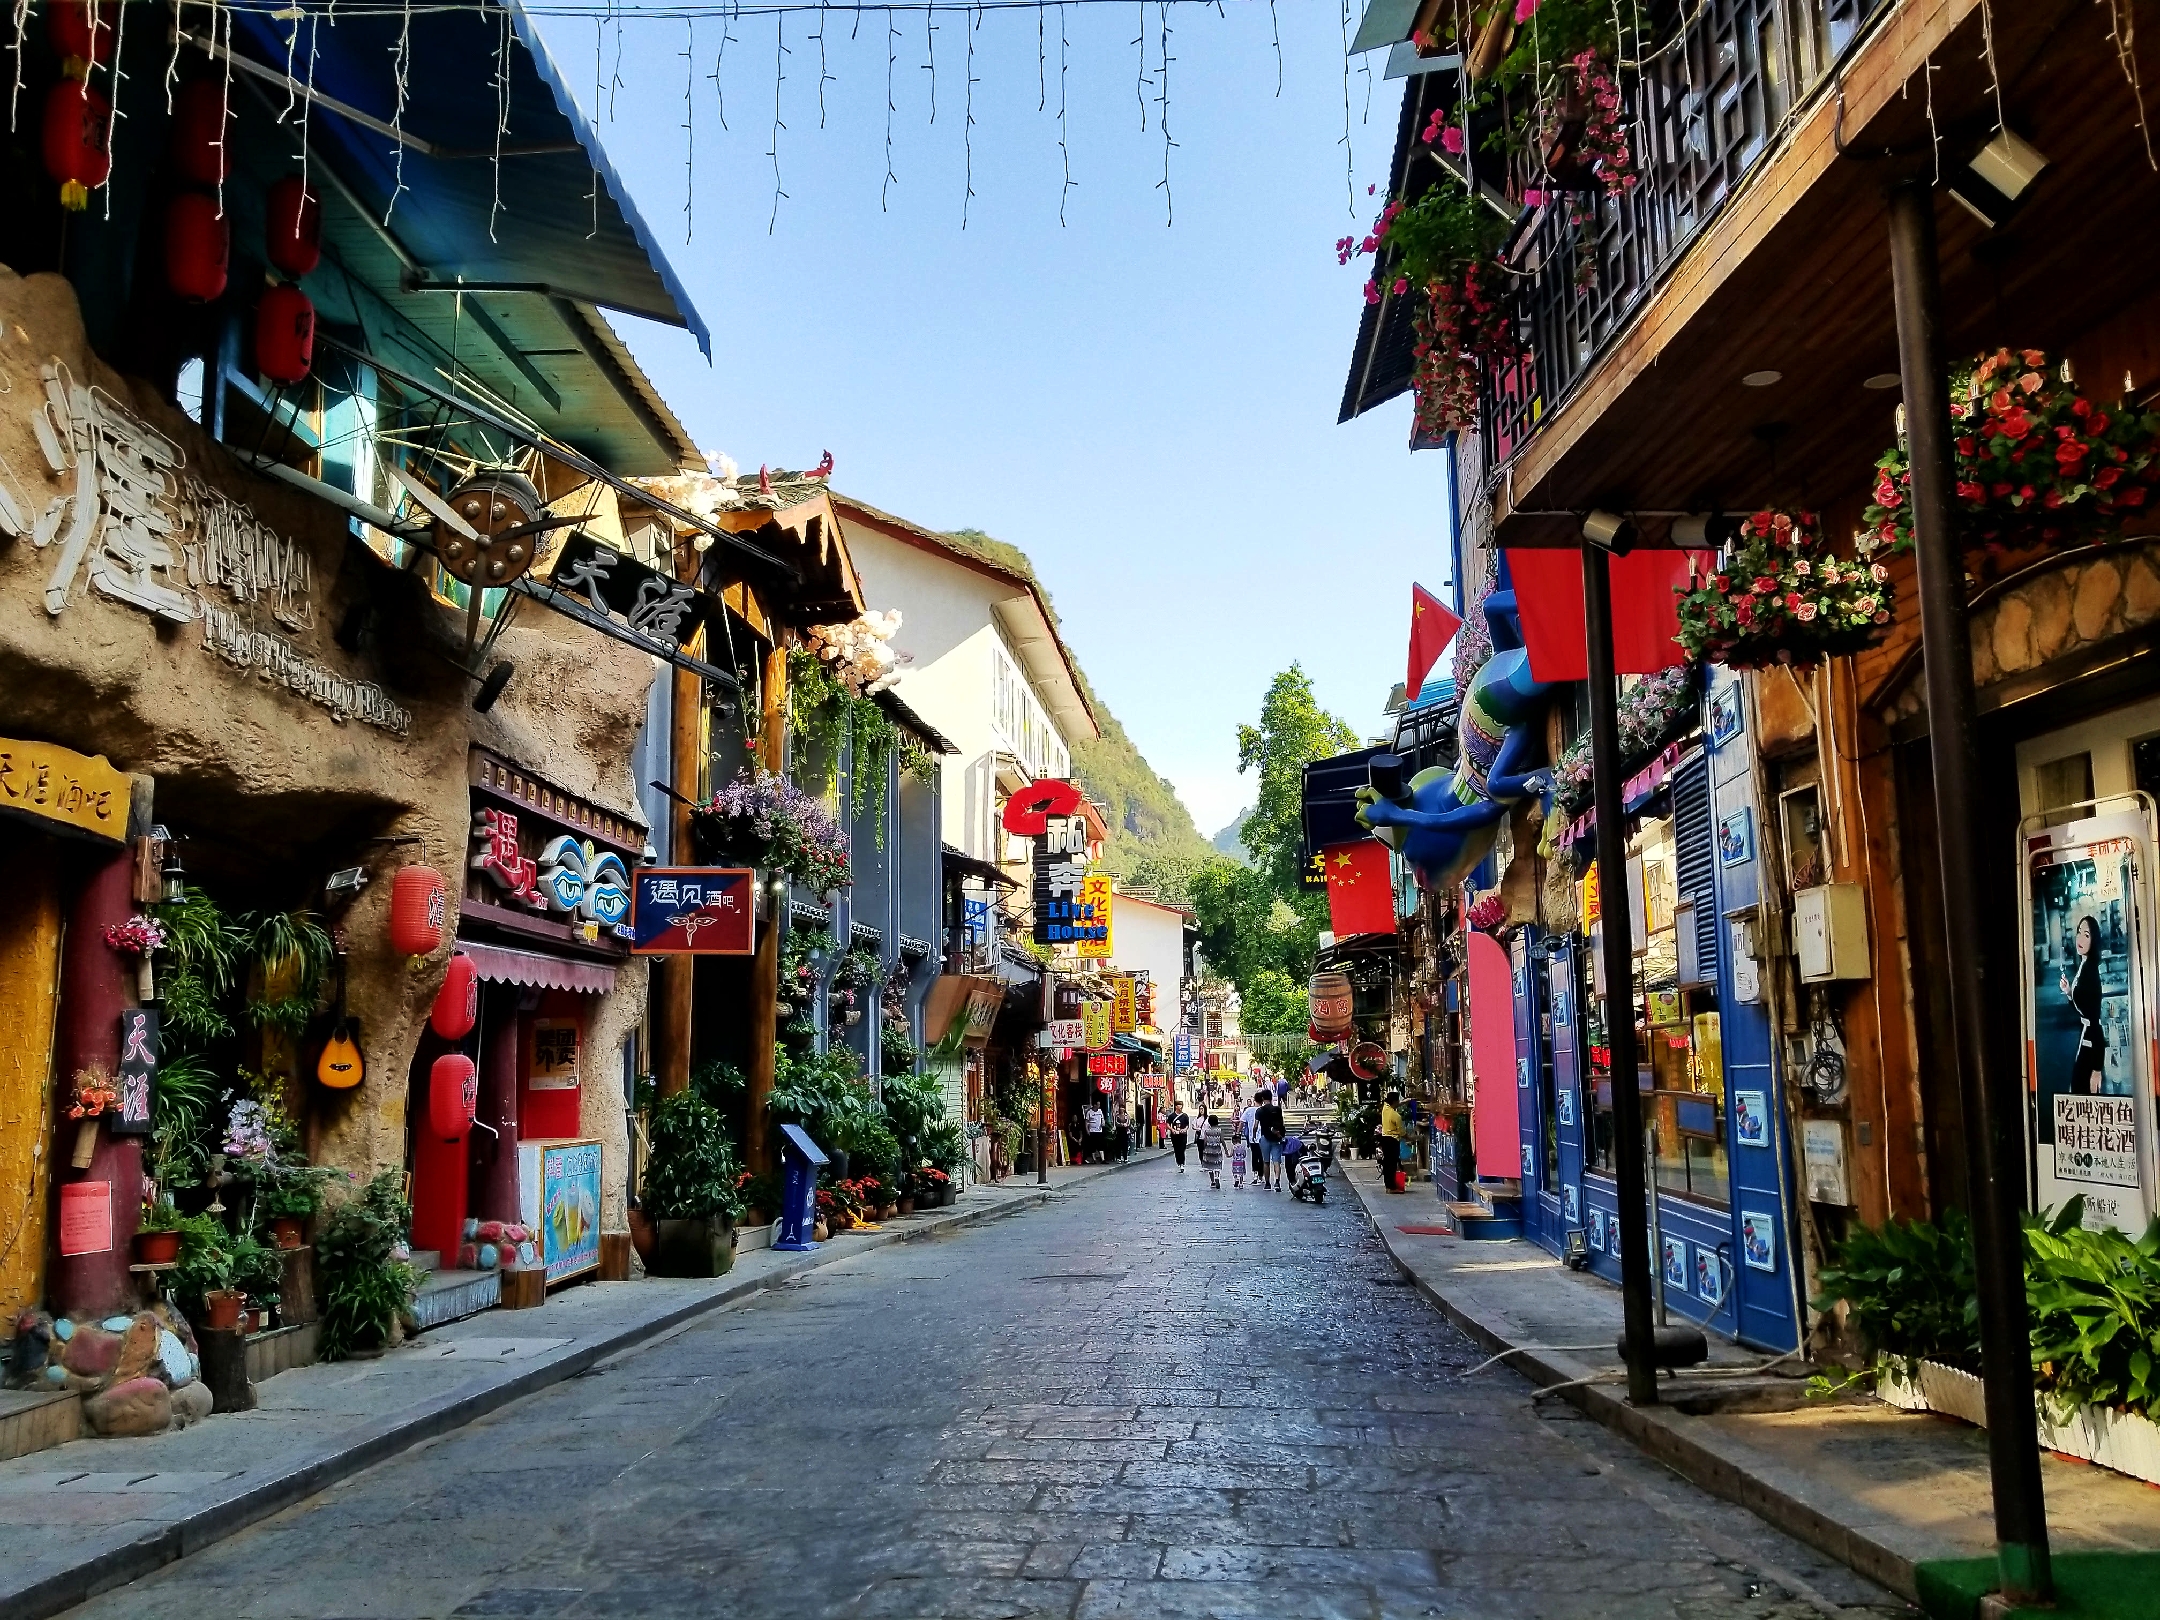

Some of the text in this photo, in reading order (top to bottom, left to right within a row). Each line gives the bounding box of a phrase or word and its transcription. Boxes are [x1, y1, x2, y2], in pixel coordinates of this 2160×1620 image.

[556, 546, 695, 646] 天涯
[1046, 817, 1087, 898] 私奔
[1048, 902, 1095, 919] Live
[1047, 924, 1109, 940] House
[1050, 1021, 1084, 1039] 文化客栈
[124, 1013, 156, 1123] 天涯
[1100, 1077, 1113, 1091] 粥
[2056, 1098, 2135, 1126] 吃啤酒鱼
[2057, 1123, 2136, 1154] 喝桂花酒
